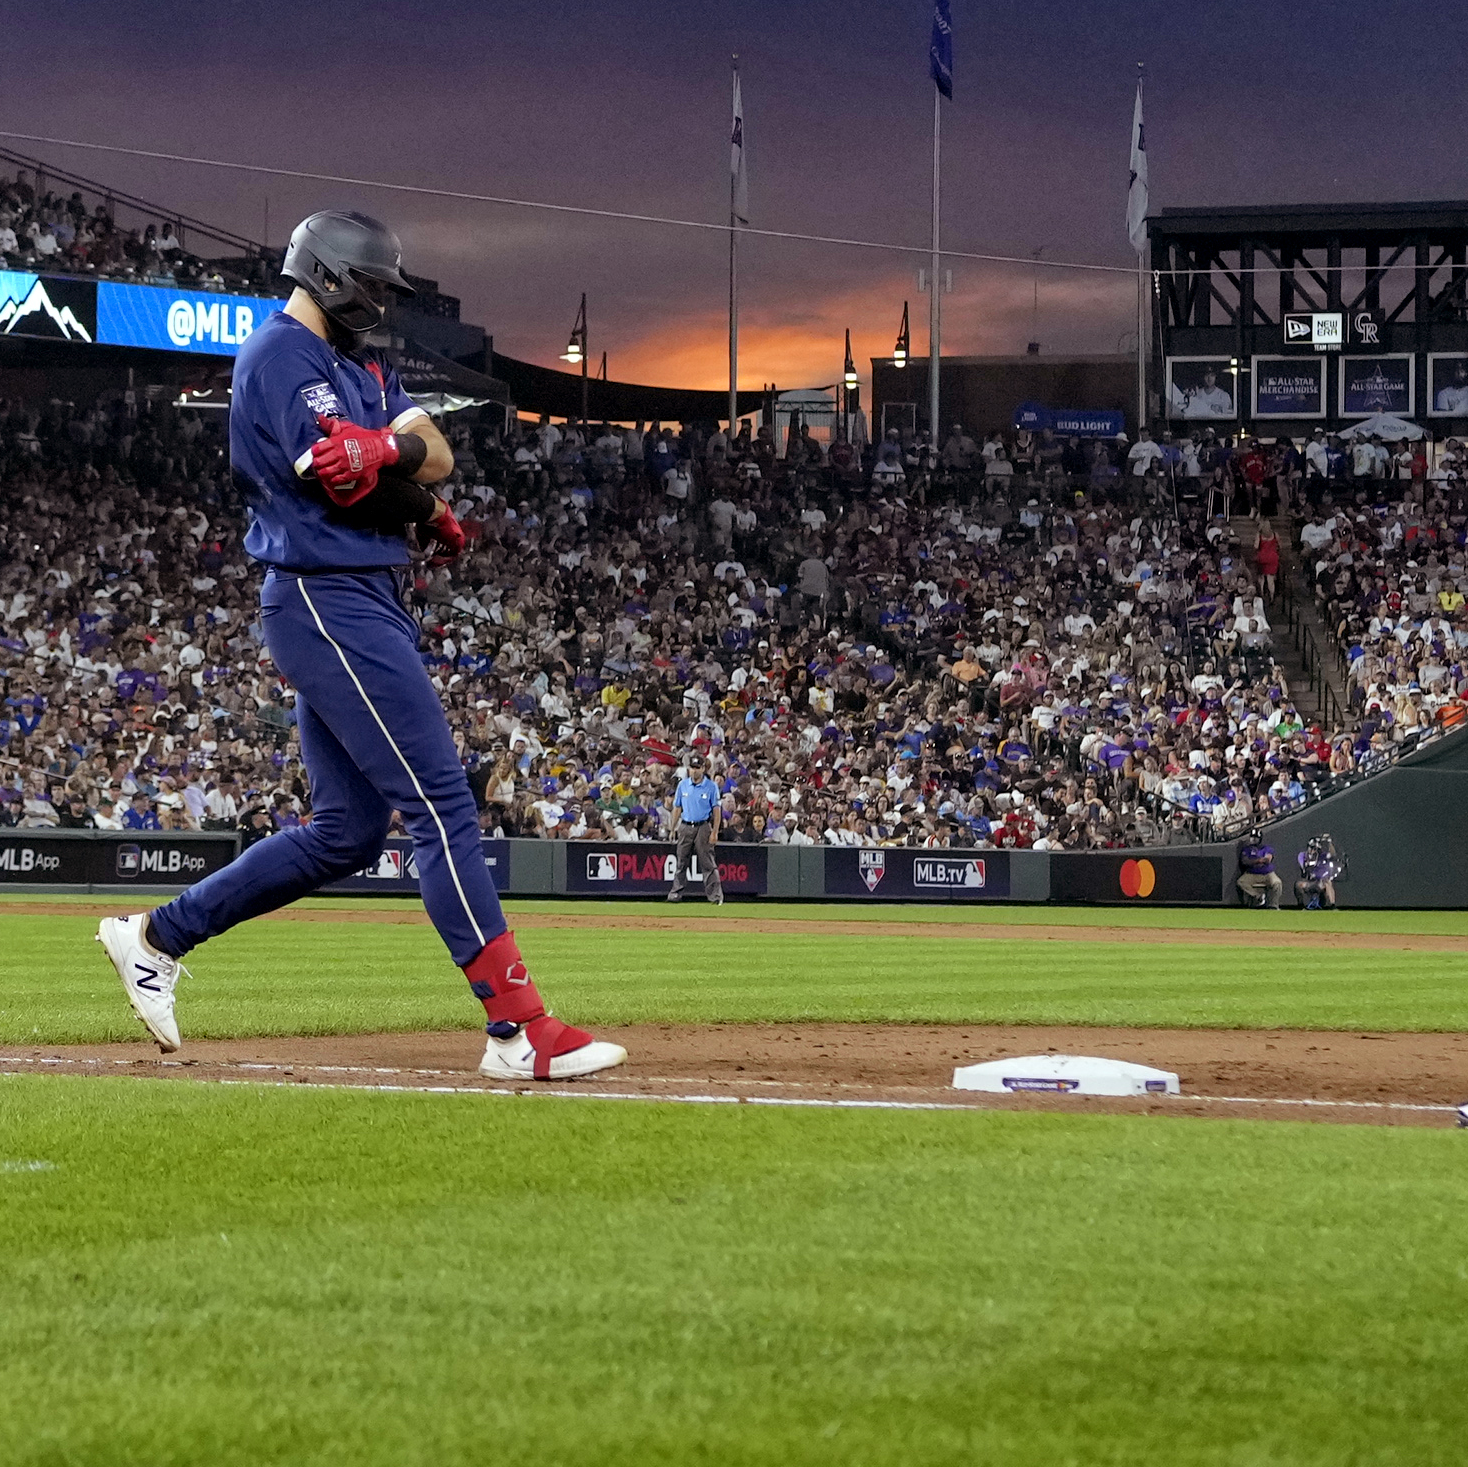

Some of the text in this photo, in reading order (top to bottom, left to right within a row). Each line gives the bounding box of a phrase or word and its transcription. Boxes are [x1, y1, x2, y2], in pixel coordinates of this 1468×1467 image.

[167, 299, 254, 347] @MLB
[1317, 320, 1338, 328] NEW
[1317, 329, 1338, 337] ERA
[1314, 344, 1326, 352] TEAM
[1259, 385, 1318, 394] MERCHANDISE
[1057, 421, 1111, 430] BUD LIGHT
[35, 853, 61, 870] App
[141, 849, 206, 872] MLB App
[860, 852, 883, 864] MLB
